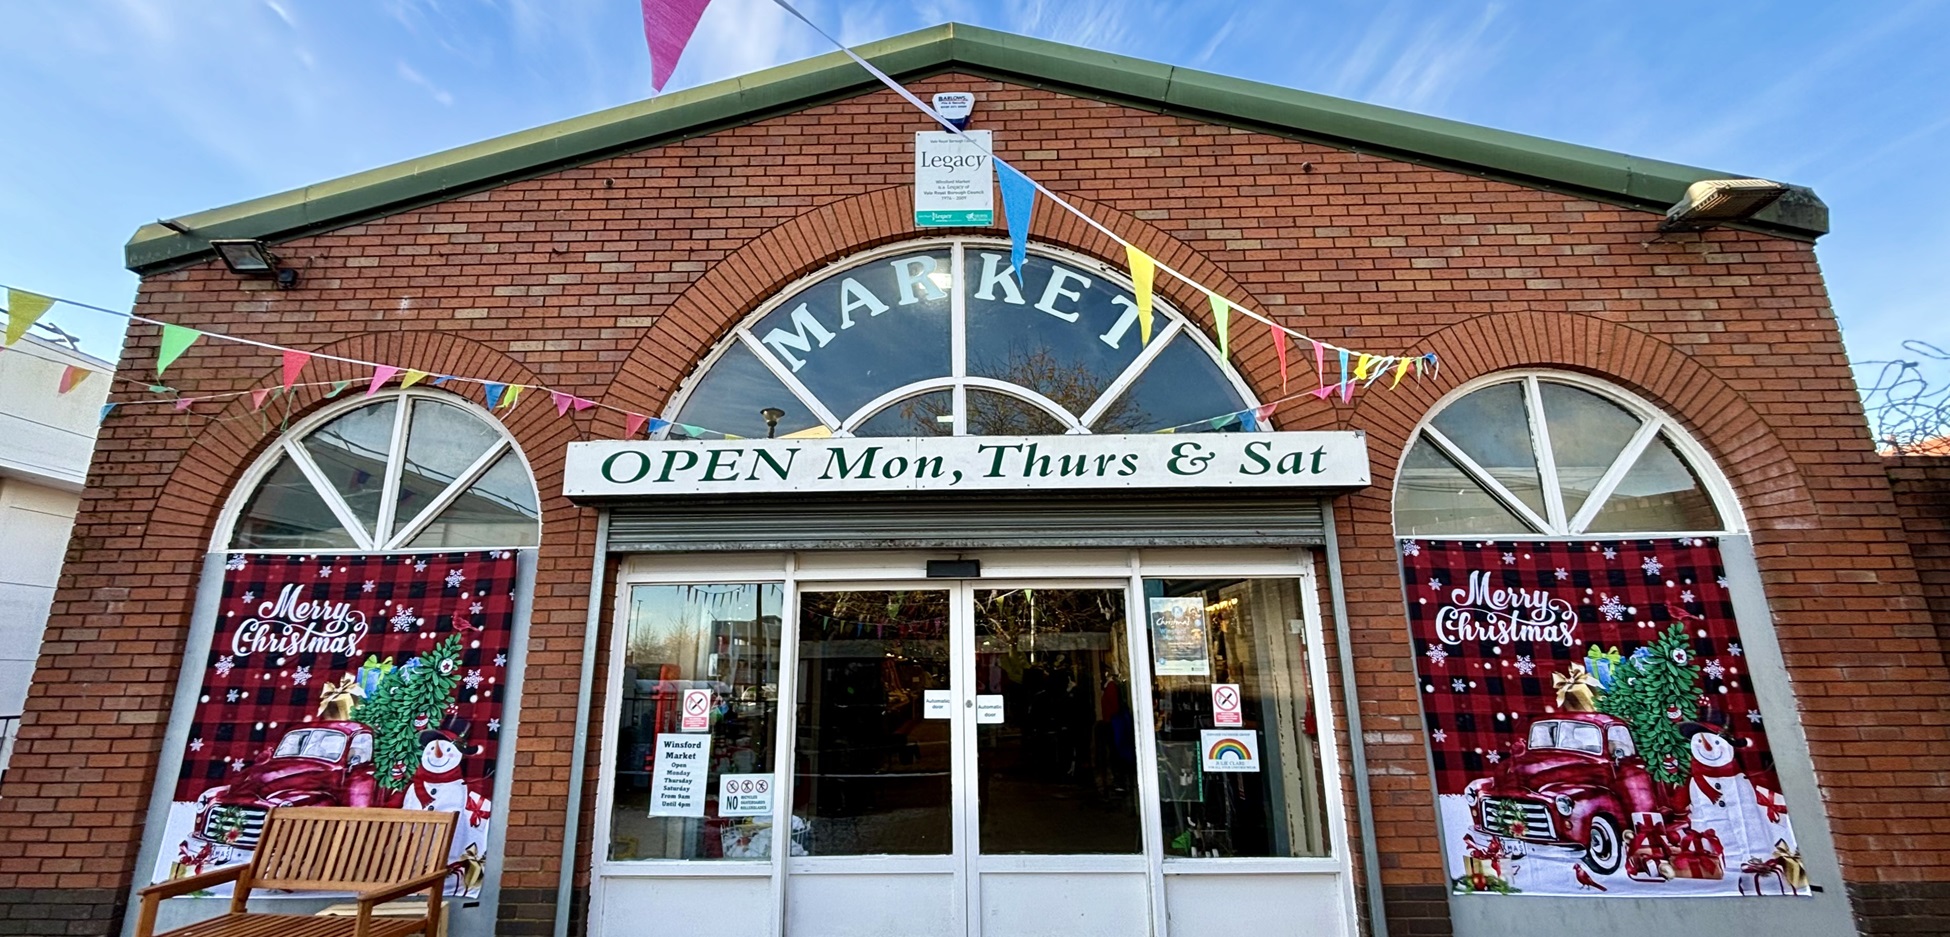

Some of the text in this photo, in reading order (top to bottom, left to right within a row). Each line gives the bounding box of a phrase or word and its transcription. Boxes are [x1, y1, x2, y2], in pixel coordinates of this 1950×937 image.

[921, 151, 987, 173] Legacy
[763, 253, 1154, 372] MARKET
[601, 441, 1328, 486] OPEN Mon, Thurs & Sat
[258, 583, 353, 634] Merry
[1452, 570, 1556, 622] Merry
[232, 613, 368, 657] Christmas
[1436, 601, 1578, 647] Christmas
[664, 741, 701, 749] Winsford
[726, 795, 738, 810] NO
